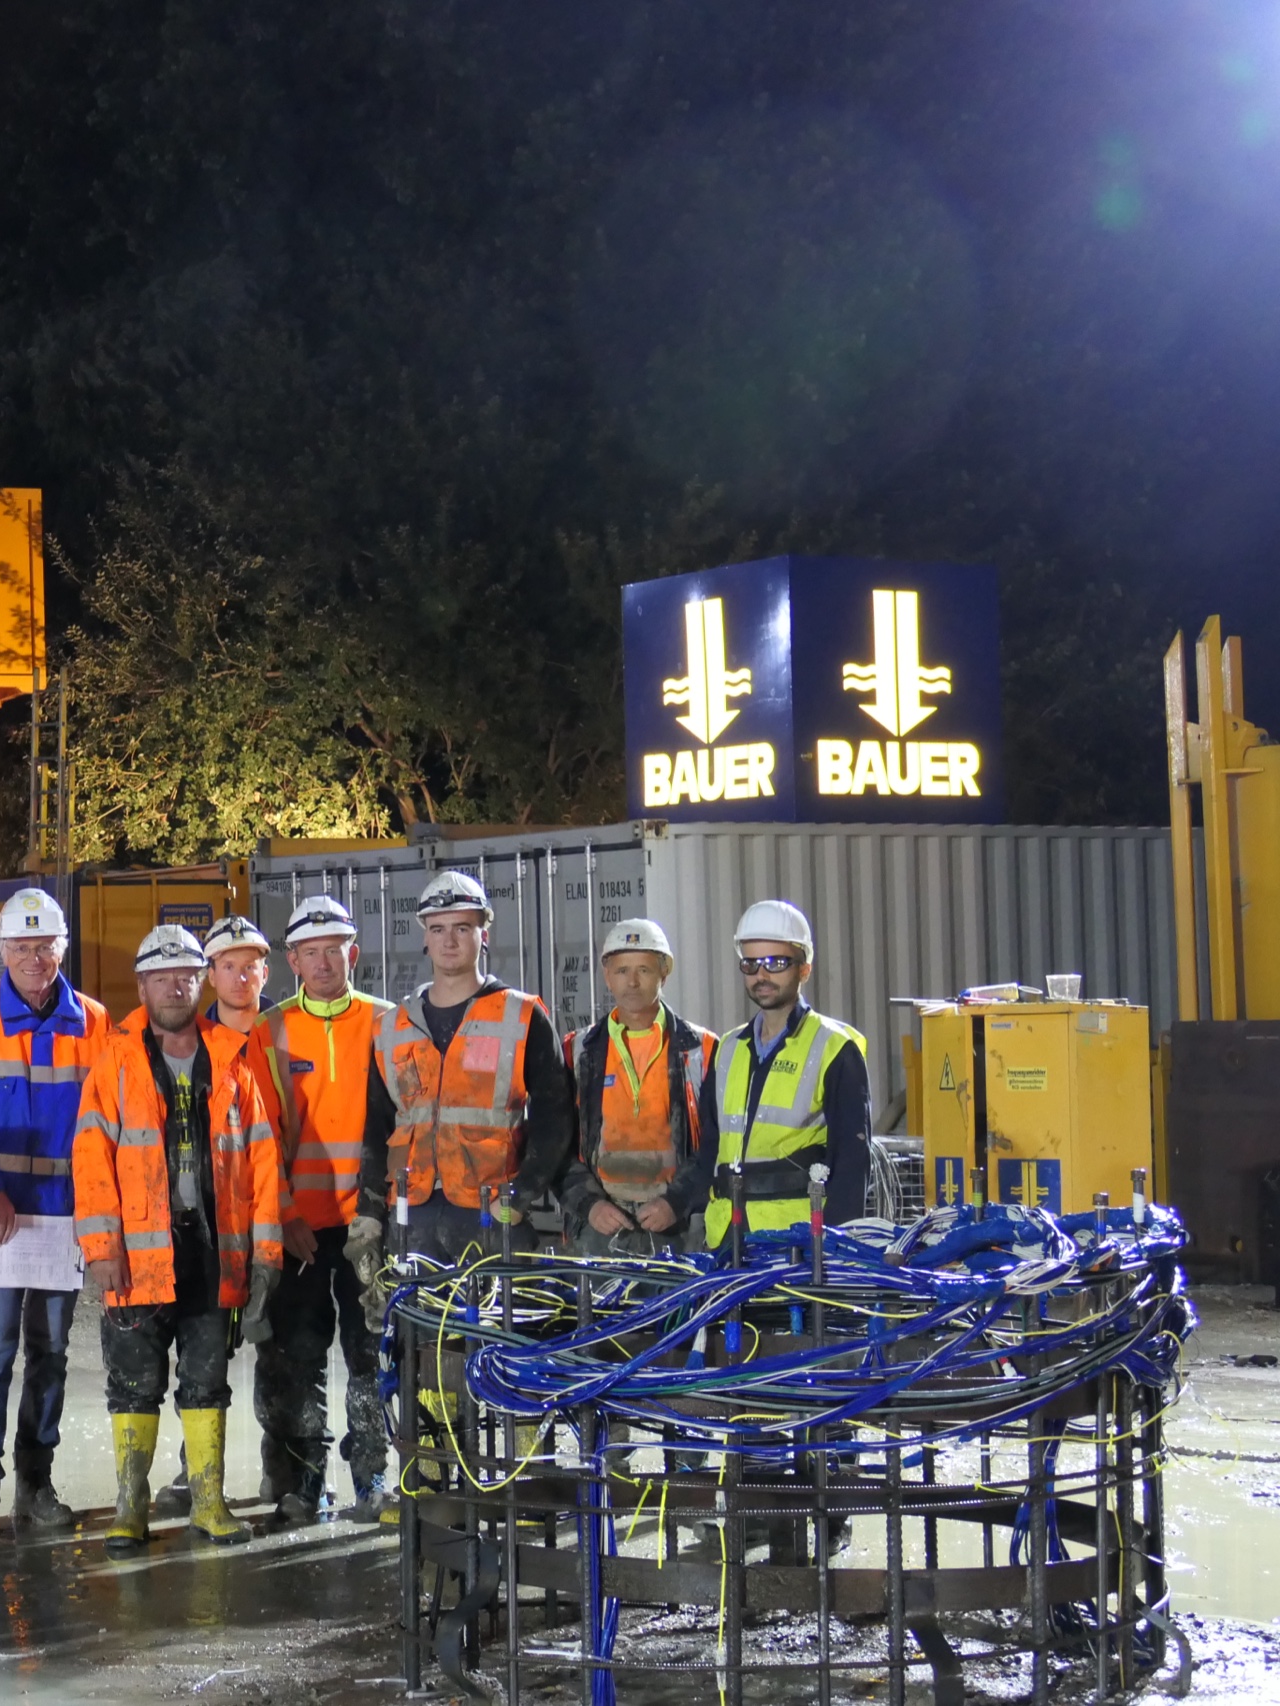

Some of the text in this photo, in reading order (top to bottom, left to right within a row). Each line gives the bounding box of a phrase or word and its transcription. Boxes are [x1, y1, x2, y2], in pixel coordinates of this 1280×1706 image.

[642, 741, 776, 808] BAUER
[816, 738, 982, 797] BAUER
[599, 879, 632, 900] 018434
[638, 878, 645, 897] 5
[163, 913, 209, 926] PFÄHLE
[600, 904, 622, 923] 2261
[392, 919, 410, 936] 2261
[562, 975, 578, 993] TARE
[562, 995, 576, 1013] NET
